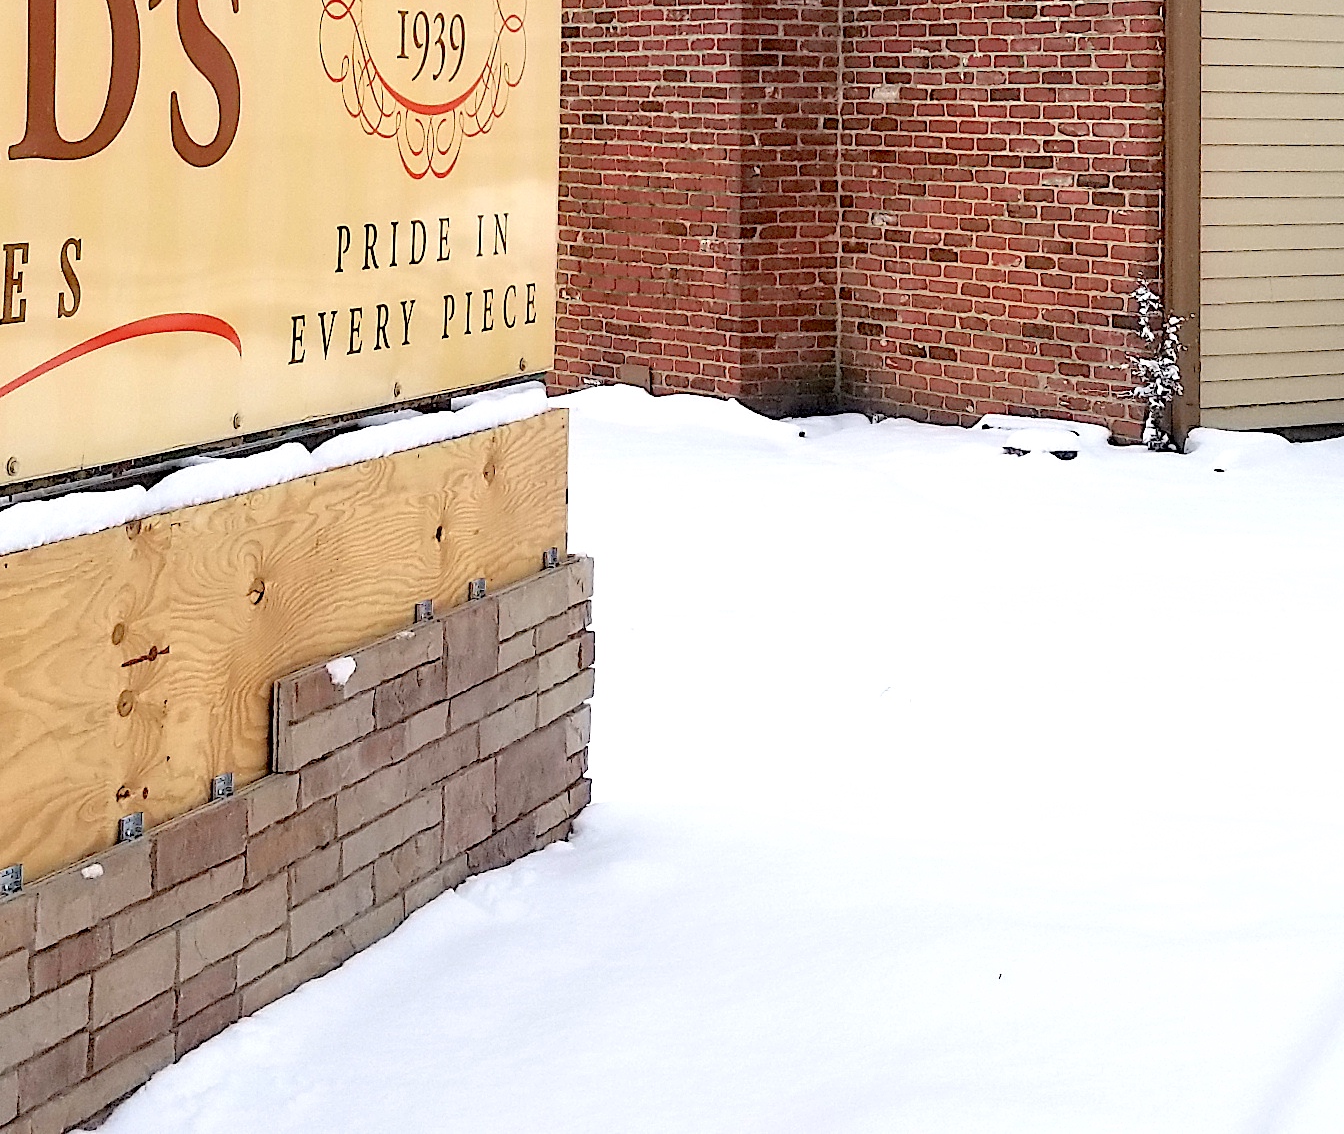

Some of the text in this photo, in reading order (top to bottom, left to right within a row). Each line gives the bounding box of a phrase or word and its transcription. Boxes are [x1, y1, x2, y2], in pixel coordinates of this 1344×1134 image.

[396, 9, 466, 83] 1939
[334, 212, 510, 274] PRIDE IN
[287, 282, 538, 366] EVERY PIECE
